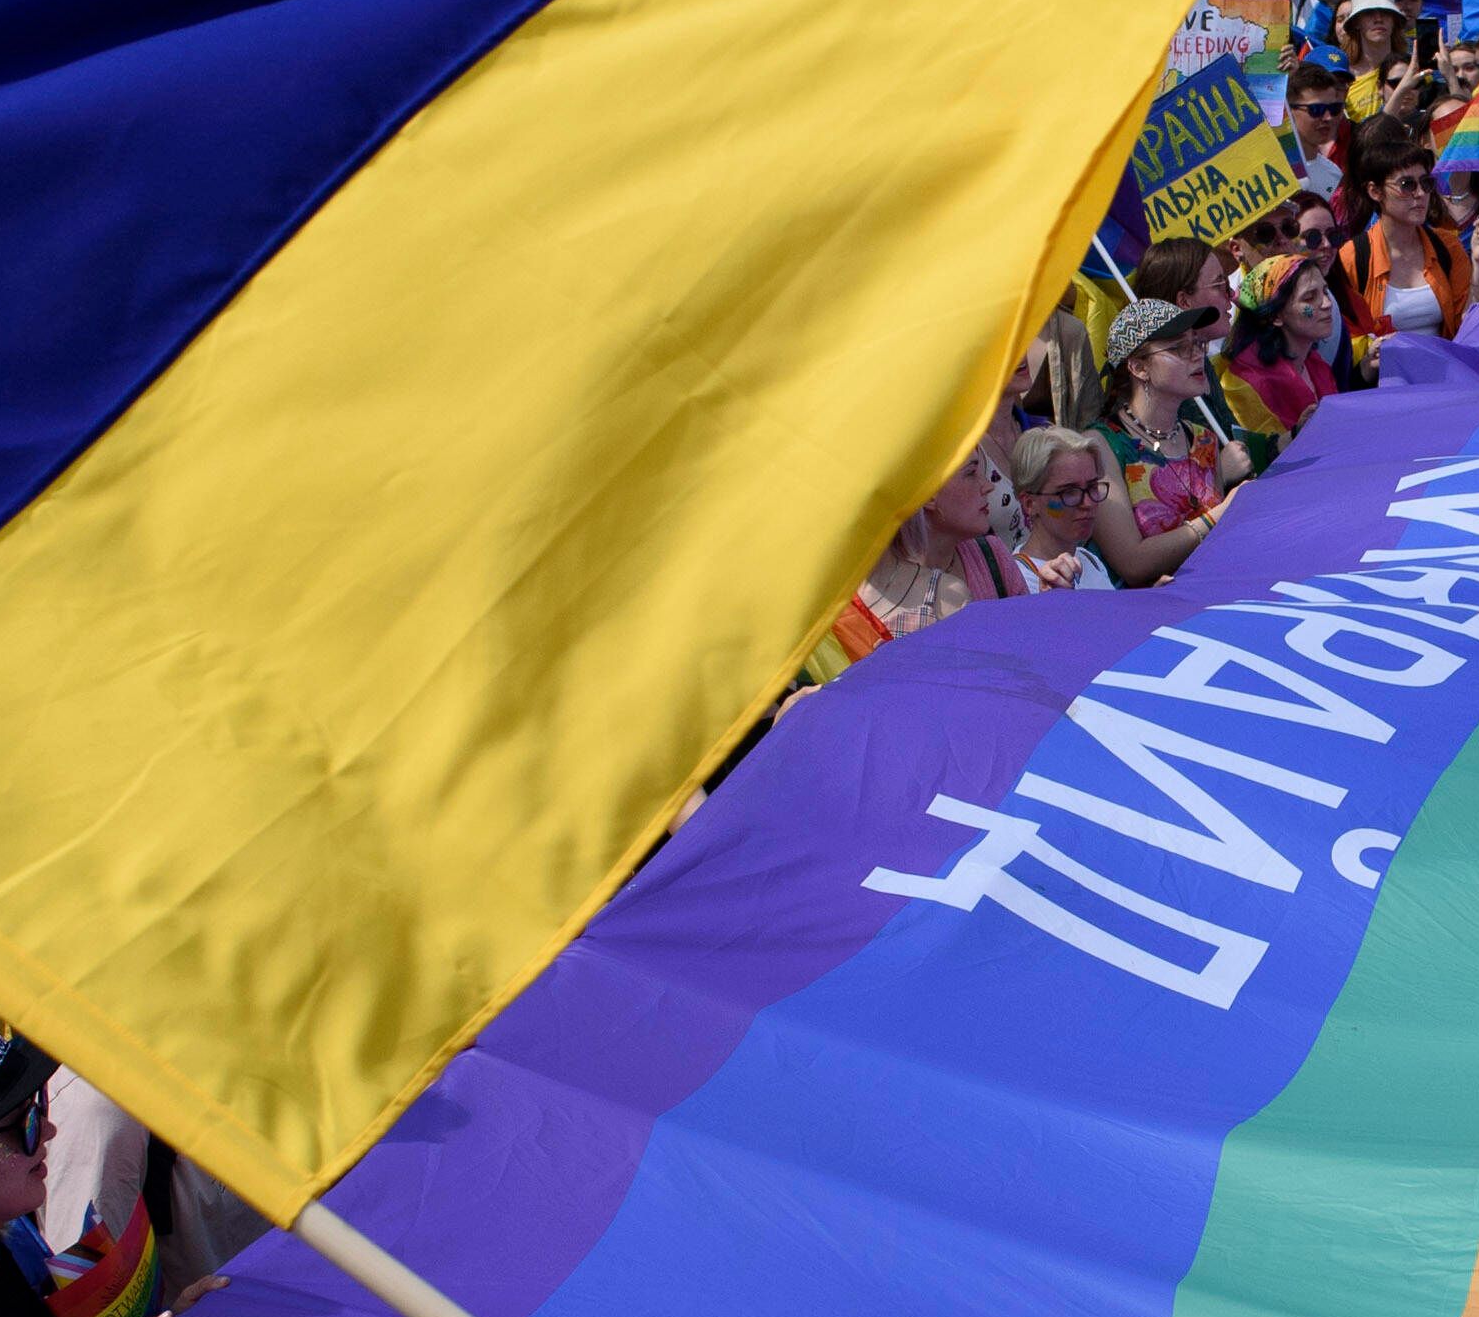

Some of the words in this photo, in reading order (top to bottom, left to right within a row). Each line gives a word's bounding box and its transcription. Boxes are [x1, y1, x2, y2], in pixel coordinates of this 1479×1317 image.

[1171, 35, 1250, 55] LEEDING
[1183, 9, 1214, 32] VE
[1132, 76, 1260, 189] РАЇНА
[1143, 164, 1229, 231] ІЛЬНА
[1187, 163, 1290, 240] КРАЇНА
